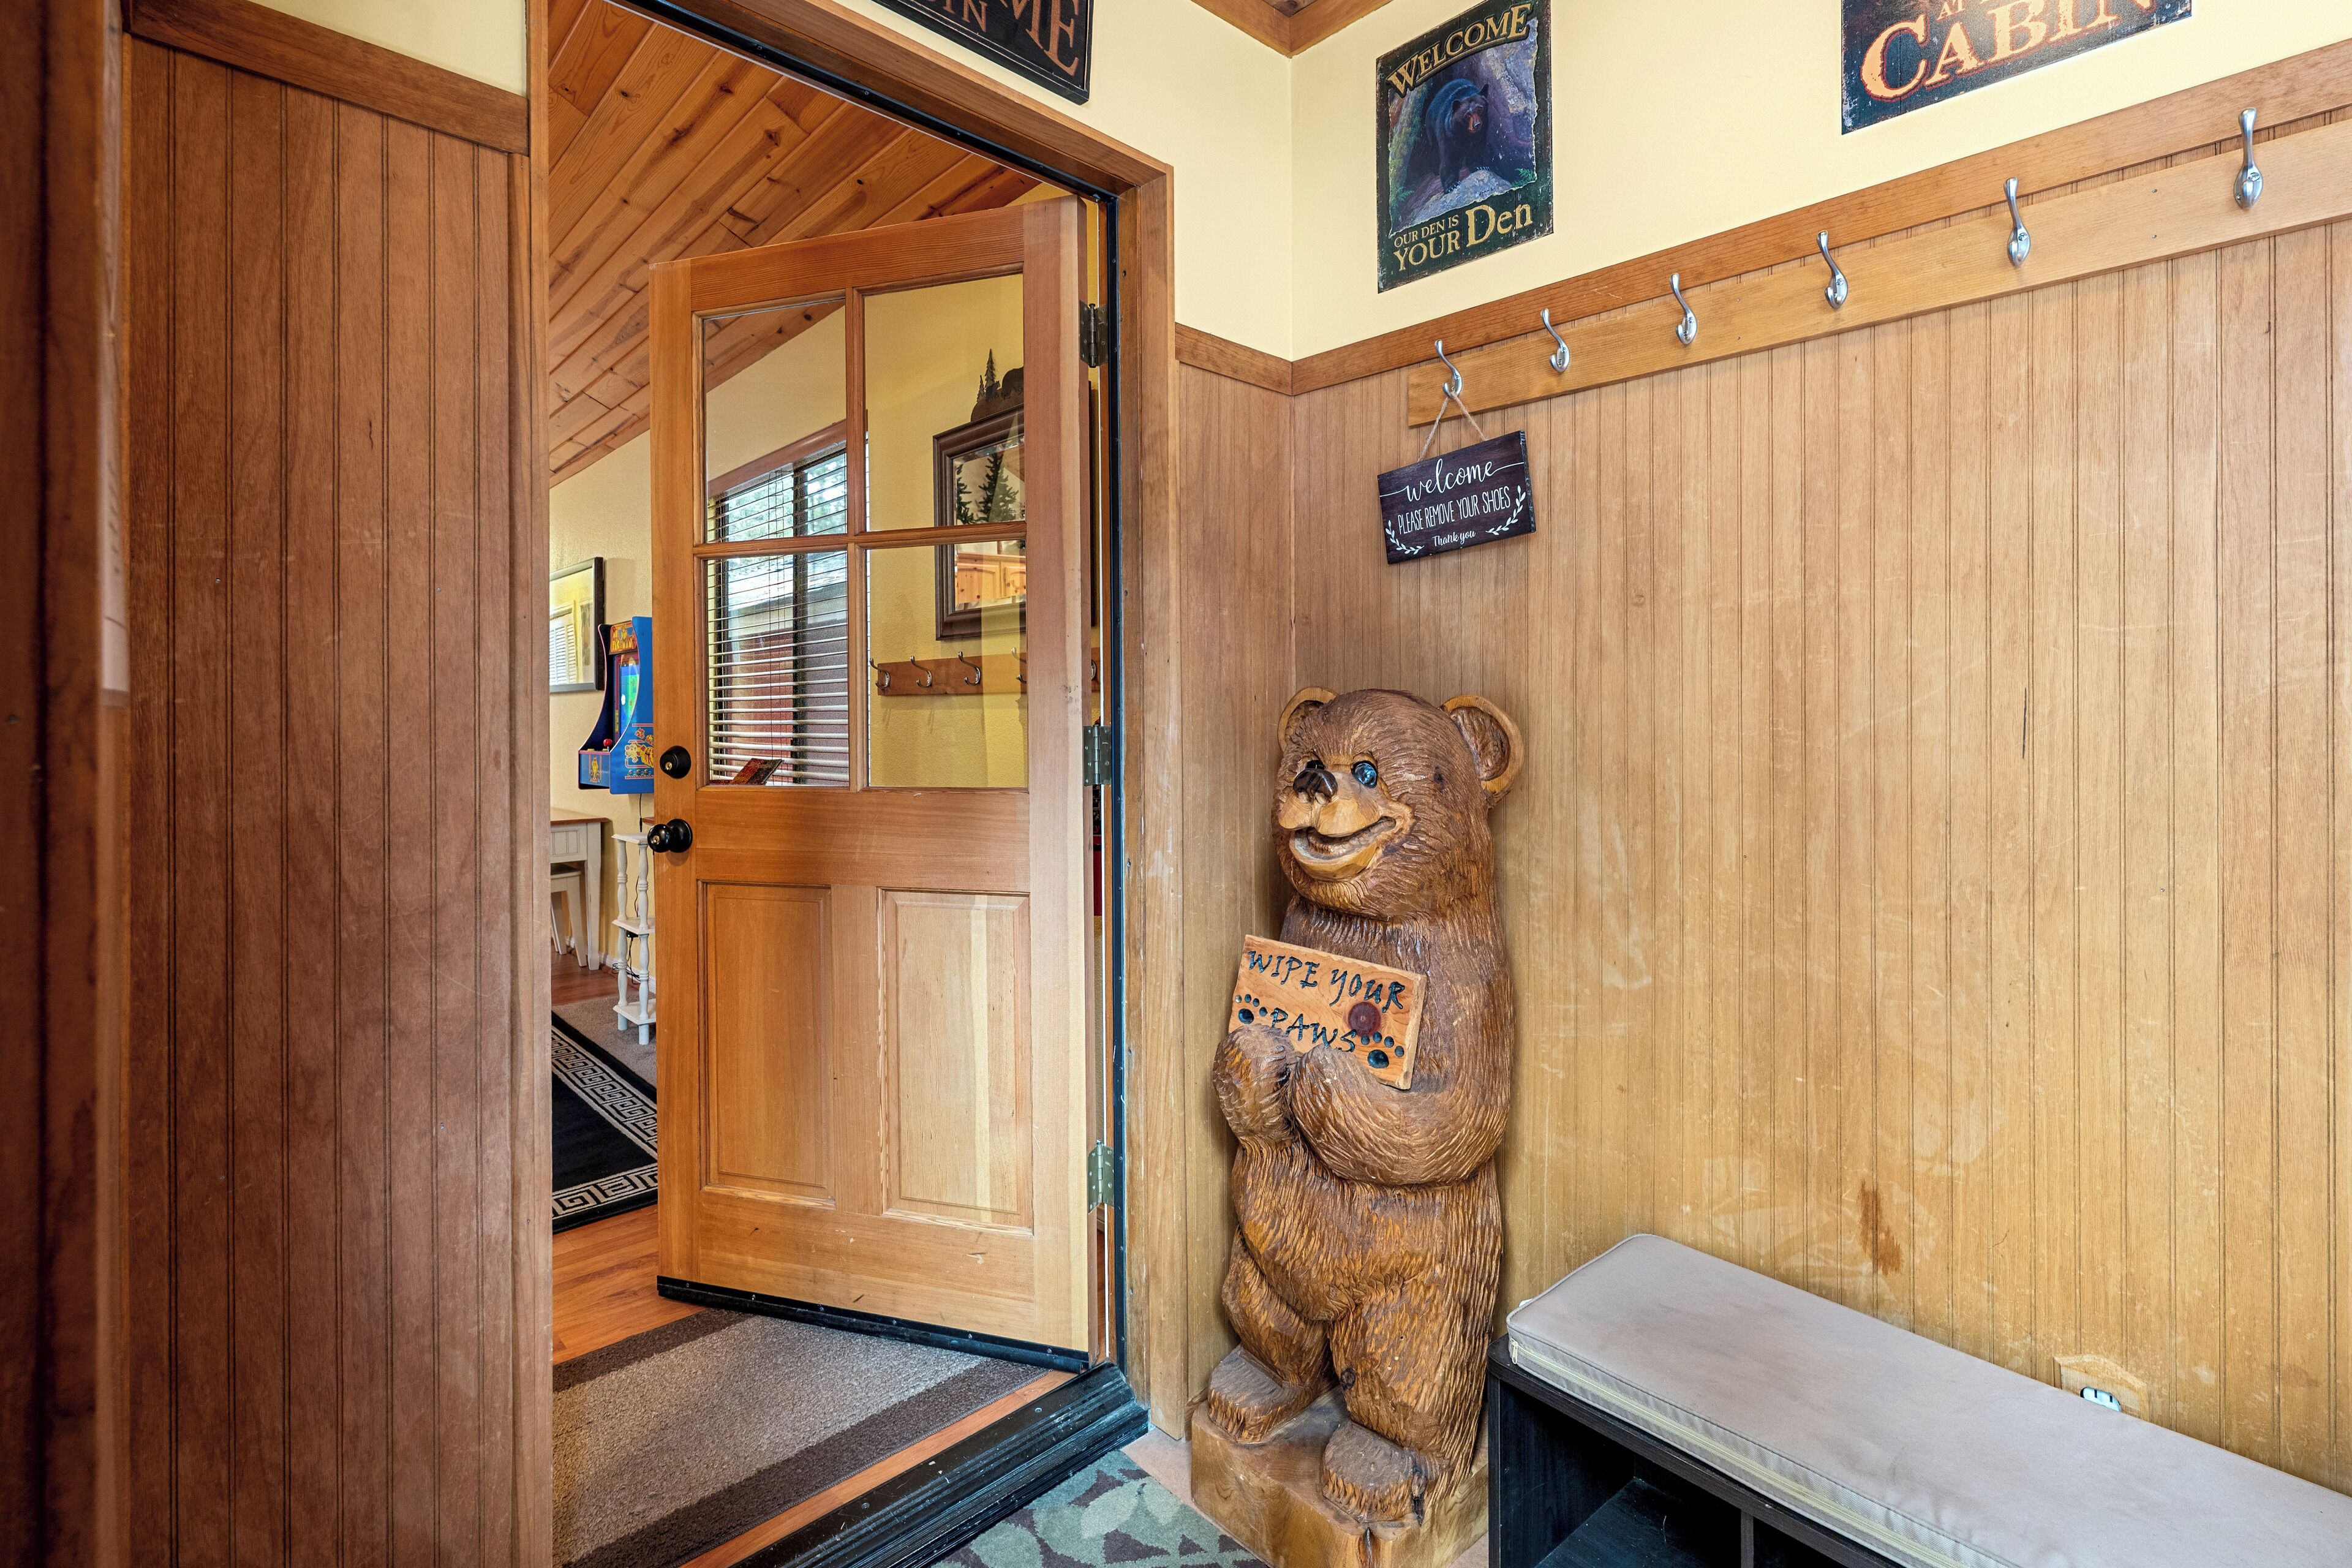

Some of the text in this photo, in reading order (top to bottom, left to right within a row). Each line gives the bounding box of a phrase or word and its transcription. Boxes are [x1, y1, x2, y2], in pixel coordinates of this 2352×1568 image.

[1387, 3, 1532, 95] WELCOME
[1393, 214, 1460, 247] OUR DEN IS
[1393, 203, 1532, 271] YOUR Den
[1398, 458, 1502, 502] welcome
[1398, 486, 1510, 535] PLEASE REMOVE YOUR SHOES
[1432, 530, 1476, 547] Thank you
[1248, 951, 1320, 988] WIPE
[1330, 968, 1405, 1013] YOUR
[1271, 1007, 1357, 1052] PAWS
